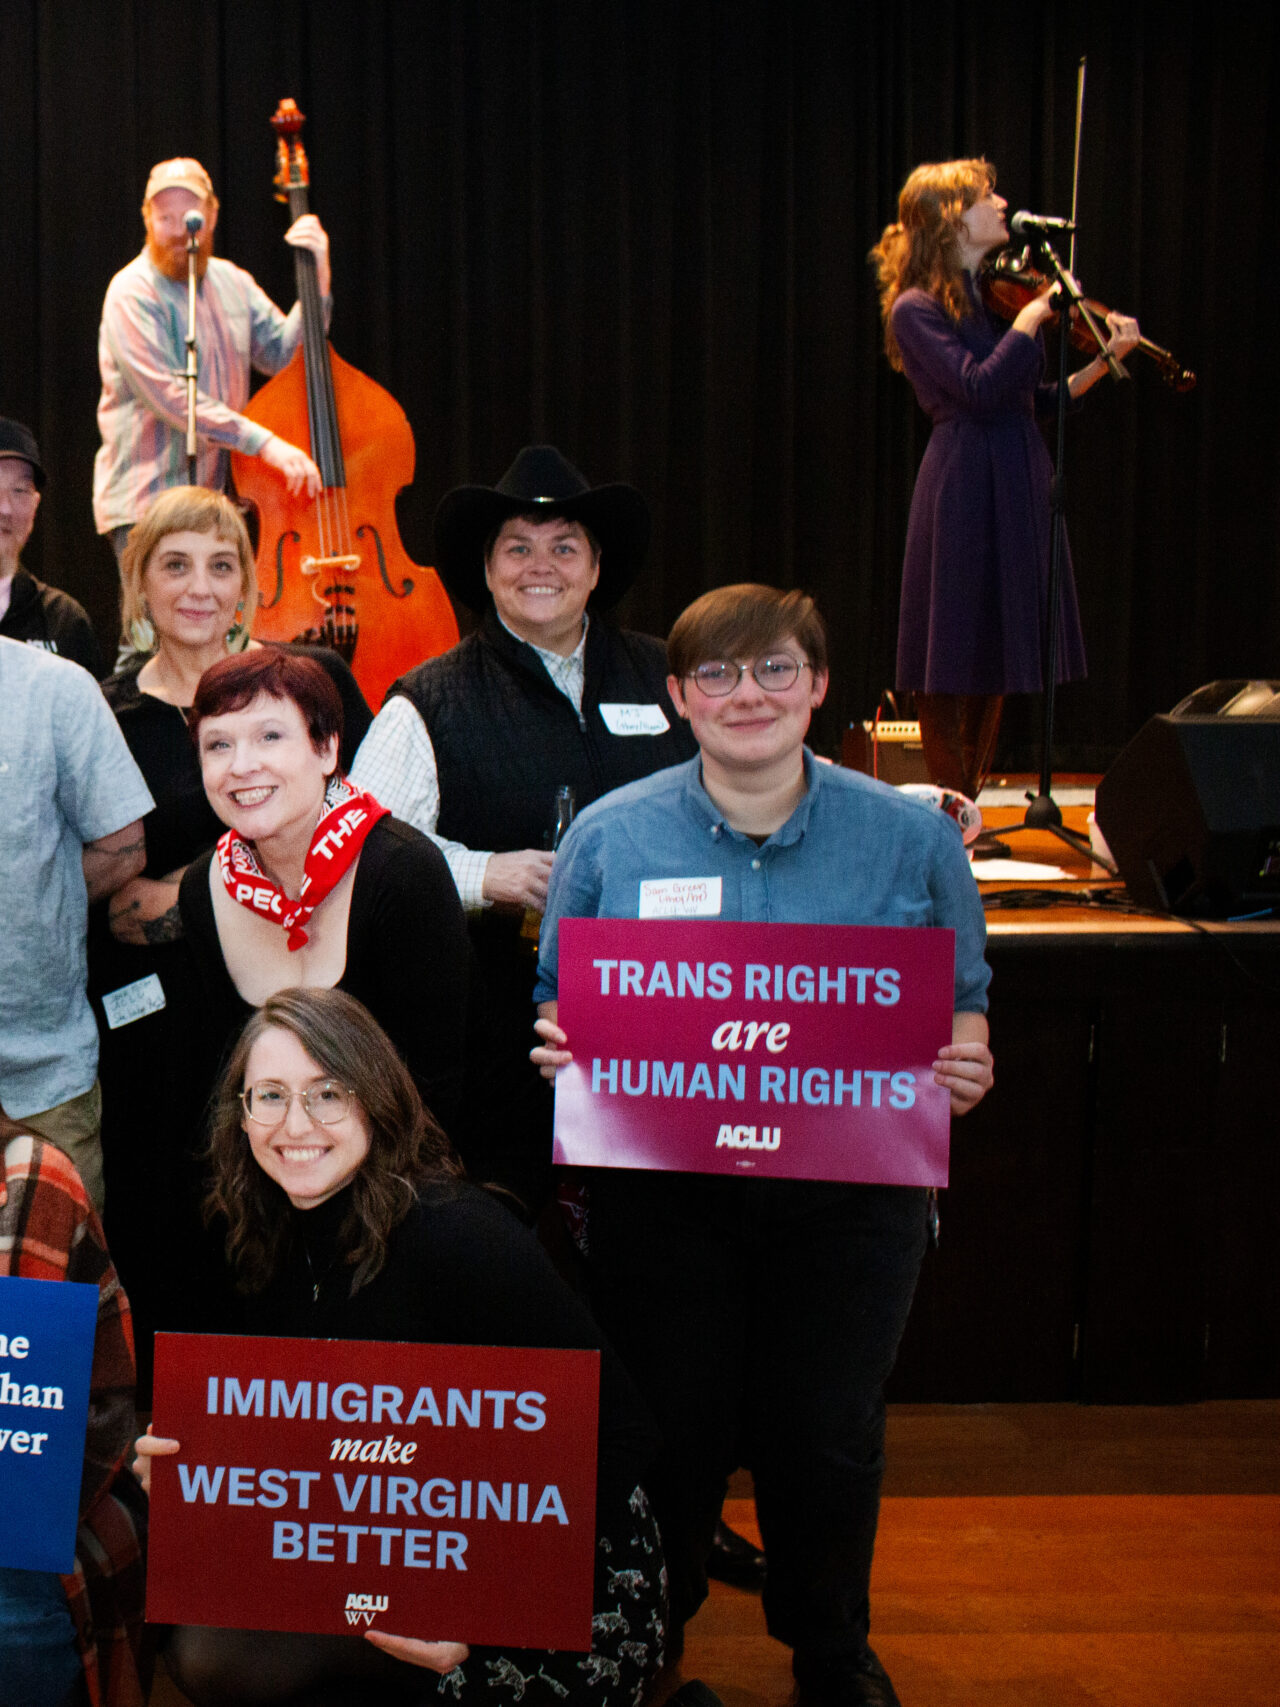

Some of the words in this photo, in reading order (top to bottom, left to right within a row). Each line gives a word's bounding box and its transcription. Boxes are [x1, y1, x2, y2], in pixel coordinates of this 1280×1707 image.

[311, 808, 368, 861] THE
[592, 958, 733, 1000] TRANS
[744, 963, 902, 1006] RIGHTS
[711, 1020, 791, 1053] are
[591, 1058, 746, 1101] HUMAN
[759, 1066, 917, 1110] RIGHTS
[715, 1124, 781, 1150] ACLU
[207, 1376, 547, 1432] IMMIGRANTS
[329, 1434, 418, 1465] make
[177, 1463, 321, 1510] WEST
[332, 1473, 570, 1525] VIRGINIA
[272, 1520, 469, 1571] BETTER
[344, 1610, 377, 1627] WV
[345, 1593, 389, 1612] ACLU
